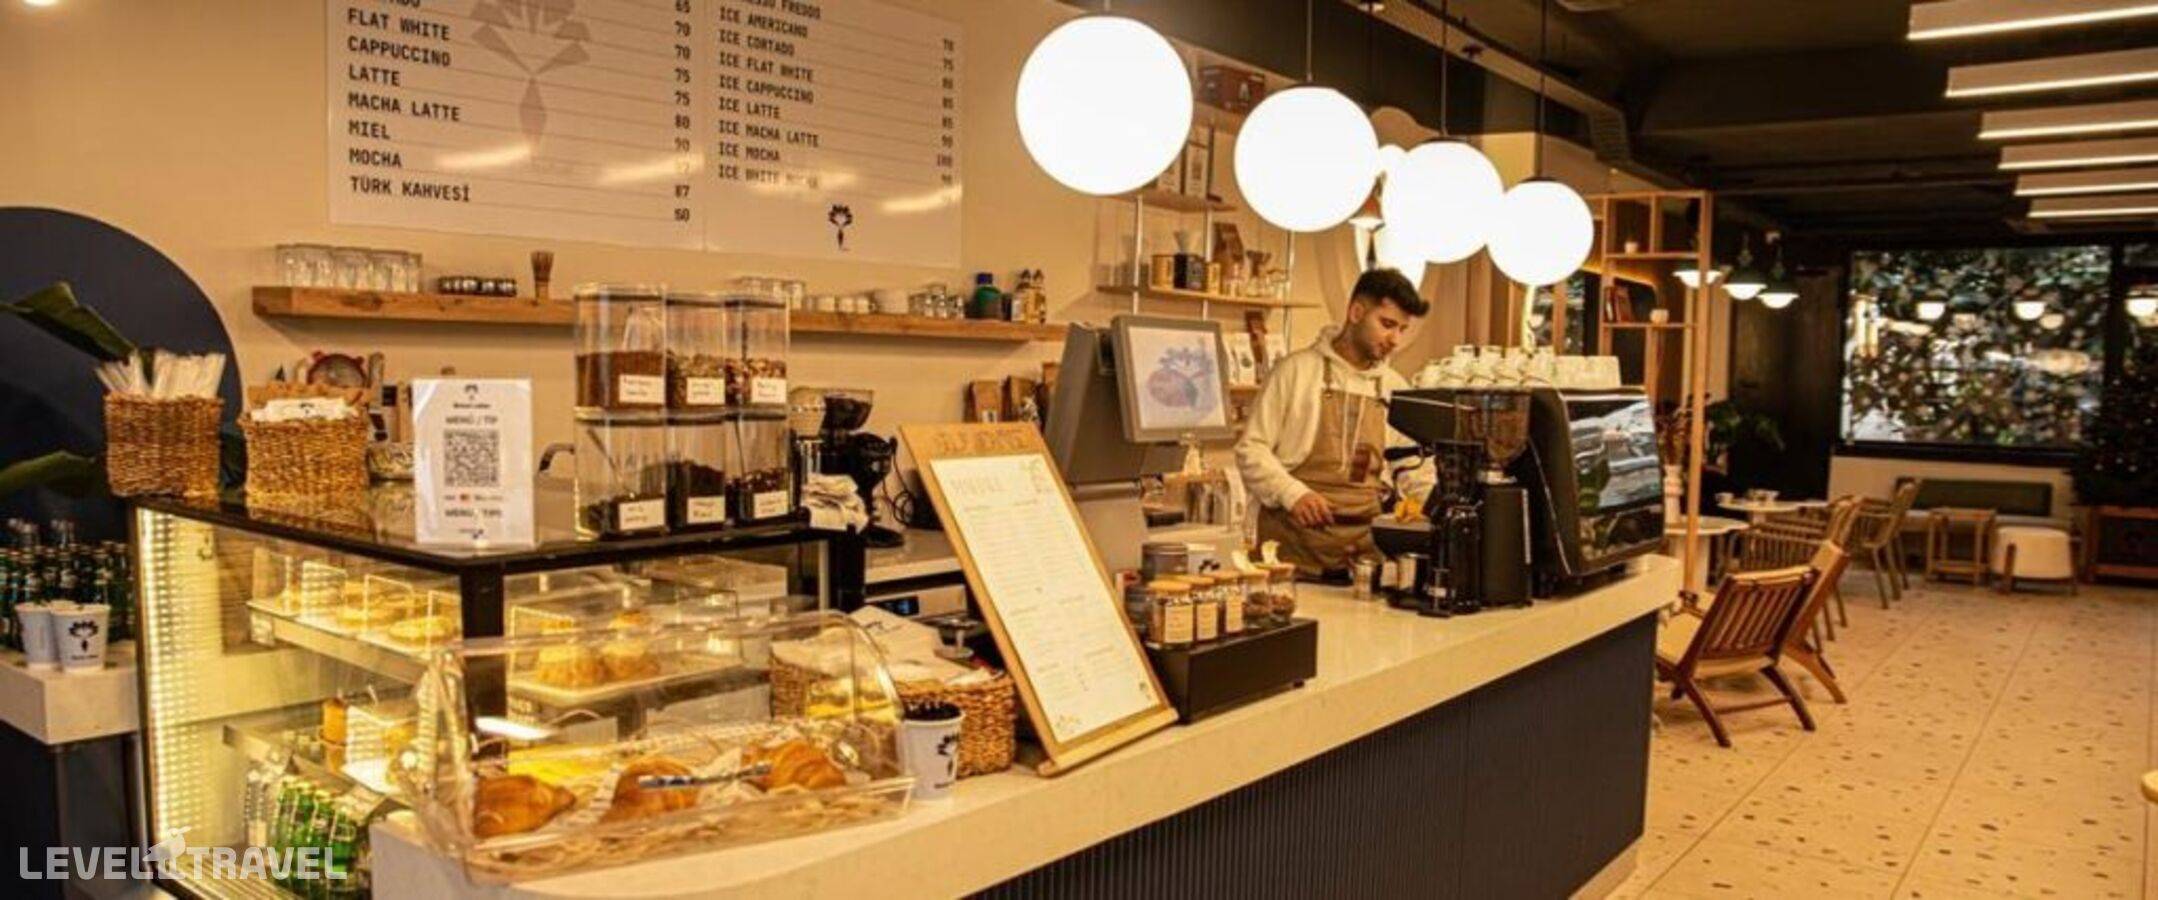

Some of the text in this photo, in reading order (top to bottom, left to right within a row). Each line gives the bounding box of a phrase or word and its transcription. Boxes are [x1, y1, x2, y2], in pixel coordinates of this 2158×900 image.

[348, 8, 450, 40] FLAT WHITE
[674, 21, 690, 37] 70
[720, 6, 808, 39] ICE AMERICANO
[348, 35, 450, 66] CAPPUCCINO
[674, 44, 690, 60] 70
[719, 29, 795, 58] ICE CORTADO
[719, 51, 740, 68] ICE
[747, 56, 773, 74] FLAT
[348, 64, 400, 87] LATTE
[674, 68, 690, 83] 75
[674, 91, 690, 106] 75
[719, 74, 814, 104] ICE CAPPUCCINO
[348, 92, 460, 122] MACHA LATTE
[719, 96, 780, 119] ICE LATTE
[348, 120, 390, 140] MIEL
[719, 119, 739, 135] ICE
[787, 131, 818, 148] LATTE
[348, 147, 402, 168] MOCHA
[719, 141, 781, 162] ICE MOCHA
[719, 164, 739, 180] ICE
[350, 174, 470, 203] TÜRK KAHVESİ
